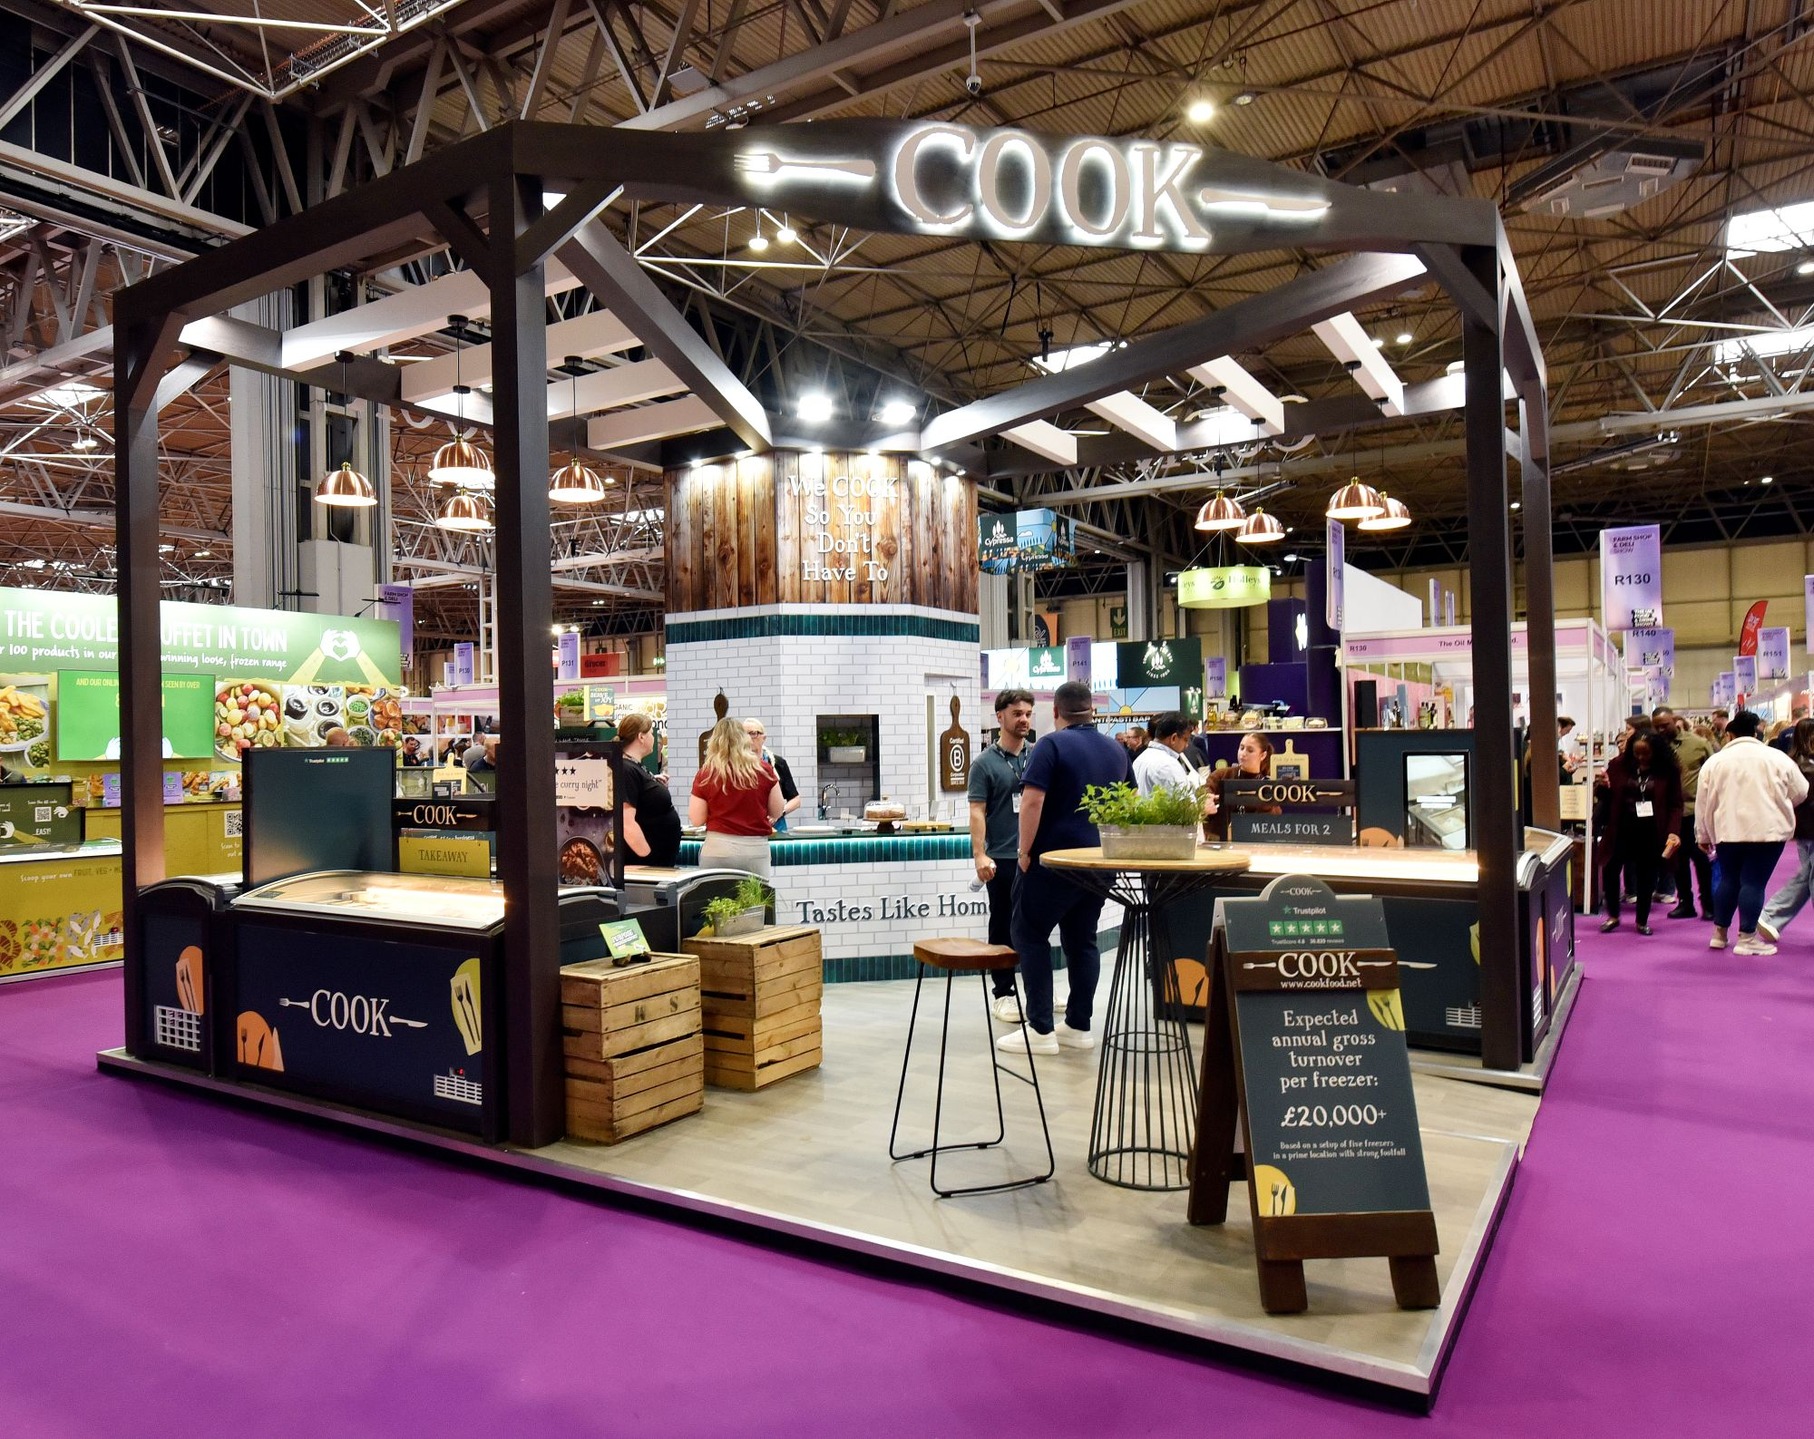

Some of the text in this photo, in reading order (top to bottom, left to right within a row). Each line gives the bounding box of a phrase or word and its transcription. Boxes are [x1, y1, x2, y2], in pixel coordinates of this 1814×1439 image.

[894, 126, 1212, 242] COOK
[788, 475, 898, 498] We COOK
[804, 503, 877, 526] So You
[818, 532, 871, 553] Don't
[802, 560, 889, 581] Have To
[1615, 573, 1651, 585] R130
[4, 609, 288, 652] THE COOLE UFFET IN TOWN
[1114, 628, 1126, 636] EXIT
[9, 644, 28, 655] 100
[32, 645, 80, 660] products
[84, 647, 95, 658] in
[98, 651, 117, 659] our
[202, 653, 227, 667] loose,
[231, 654, 260, 669] frozen
[262, 659, 288, 671] range
[614, 703, 633, 711] GANIC
[954, 750, 962, 767] B
[561, 781, 580, 792] curry
[1258, 784, 1317, 803] COOK
[413, 805, 457, 825] COOK
[1251, 823, 1331, 835] MEALS FOR 2
[418, 850, 468, 862] TAKEAWAY
[20, 874, 39, 883] Scoop
[41, 875, 57, 883] your
[1289, 887, 1313, 896] COOK
[796, 893, 989, 924] Tastes Like Hom
[1292, 906, 1327, 916] Trustpilot
[1278, 951, 1361, 978] COOK
[1280, 977, 1362, 989] www.cookfood.net
[310, 988, 392, 1037] COOK
[669, 995, 679, 1013] S
[1283, 1009, 1359, 1031] Expected
[1271, 1030, 1376, 1052] annual gross
[1289, 1050, 1362, 1067] turnover
[1280, 1070, 1379, 1094] per freezer:
[1280, 1104, 1387, 1128] £20,000+
[1280, 1141, 1301, 1150] Based
[1319, 1140, 1338, 1151] setup
[1339, 1140, 1347, 1148] of
[1348, 1139, 1363, 1147] five
[1364, 1139, 1394, 1147] freezers
[1288, 1151, 1308, 1161] prime
[1309, 1150, 1337, 1159] location
[1339, 1149, 1355, 1158] with
[1380, 1148, 1406, 1157] footfall
